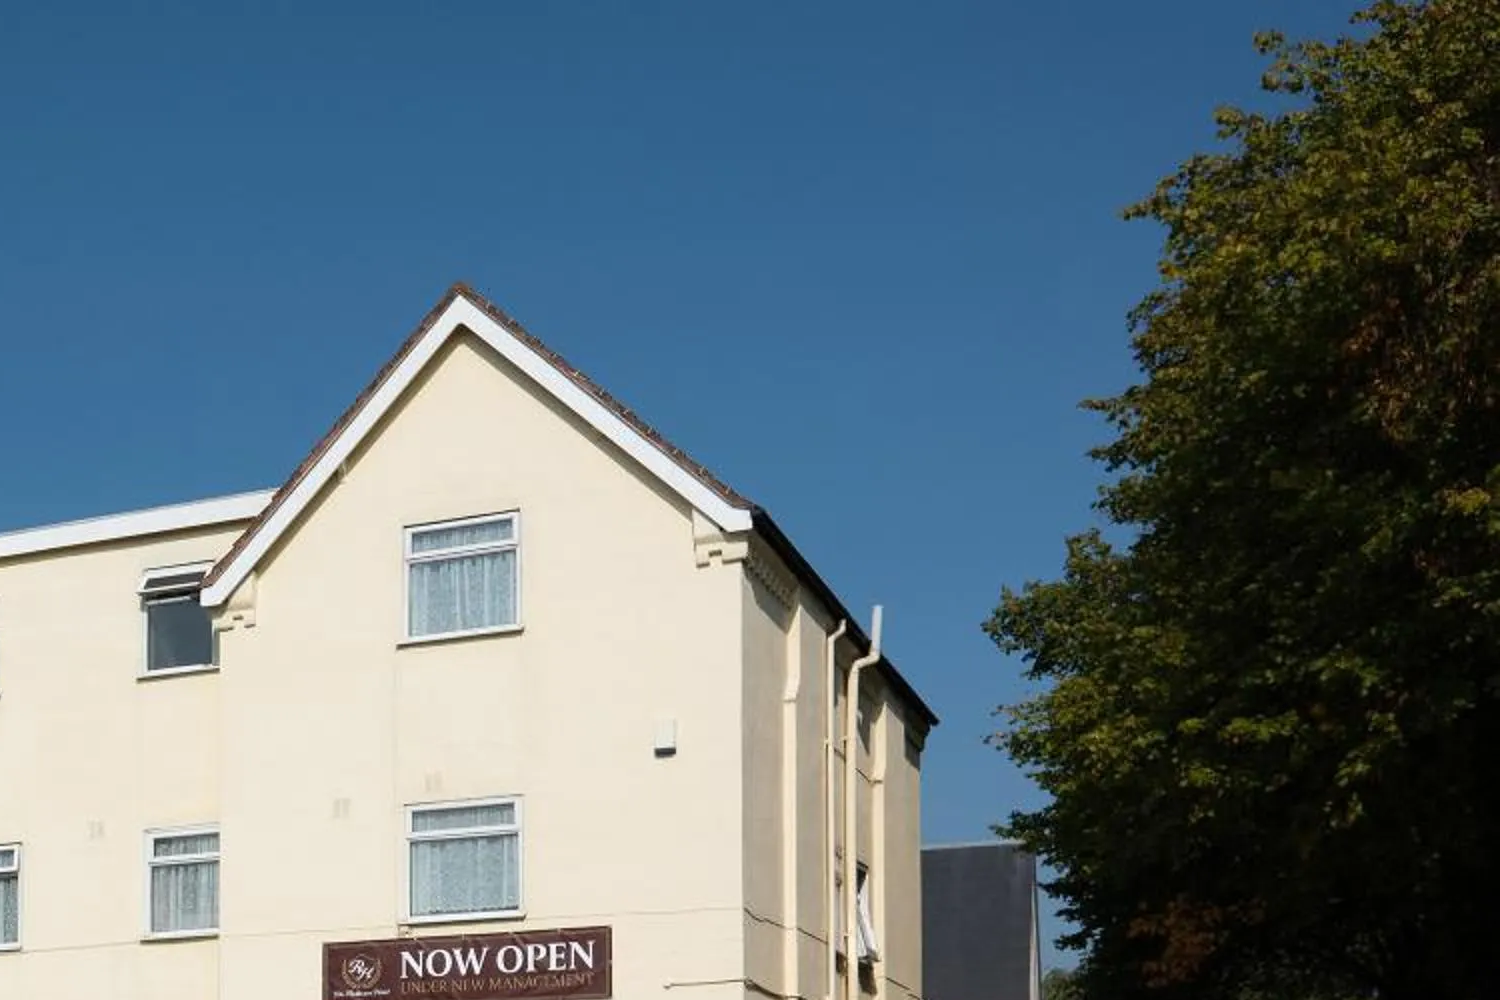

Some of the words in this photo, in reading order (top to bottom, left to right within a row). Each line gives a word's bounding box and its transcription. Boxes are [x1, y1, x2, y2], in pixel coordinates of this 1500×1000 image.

[400, 946, 489, 979] NOW
[496, 940, 595, 973] OPEN
[401, 980, 448, 994] UNDER
[451, 977, 486, 993] NEW
[488, 971, 595, 990] MANAGEMENT
